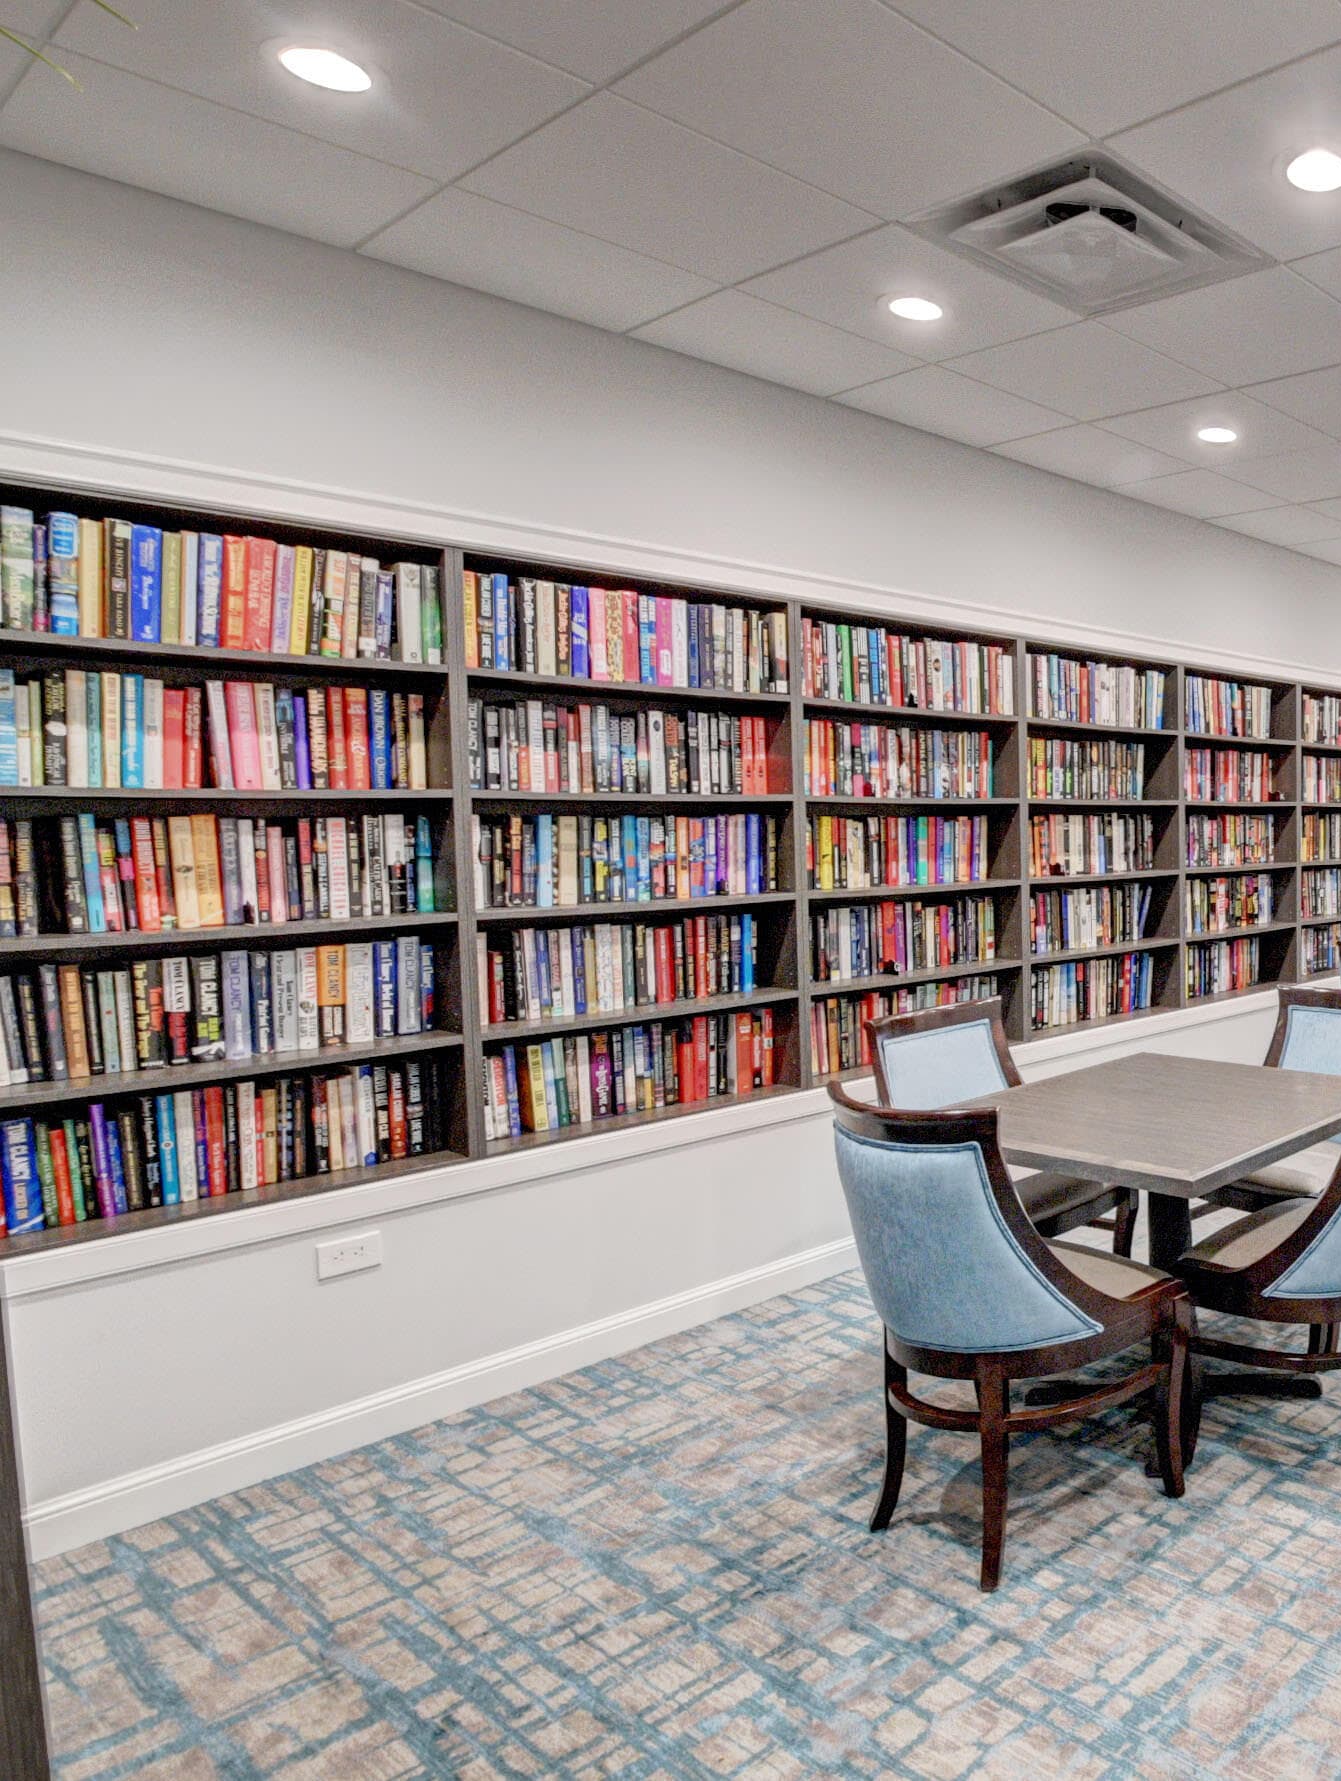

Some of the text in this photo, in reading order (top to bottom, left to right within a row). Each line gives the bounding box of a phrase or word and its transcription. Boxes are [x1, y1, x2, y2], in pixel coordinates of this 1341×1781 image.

[468, 702, 478, 718] TOM
[374, 692, 386, 787] DAN BROWN ORIGIN
[468, 720, 478, 751] CLANCY
[229, 956, 240, 974] TOM
[327, 950, 339, 965] TOM
[404, 942, 415, 957] TOM
[133, 963, 147, 978] The
[172, 961, 185, 1010] TOM CLANCY
[305, 951, 316, 999] TOM CLANCY
[328, 968, 340, 999] CLANCY
[405, 959, 417, 990] CLANCY
[199, 959, 219, 1016] TOM CLANCY
[230, 976, 242, 1011] CLANCY
[7, 1122, 28, 1145] TOM
[9, 1145, 32, 1180] CLANCY
